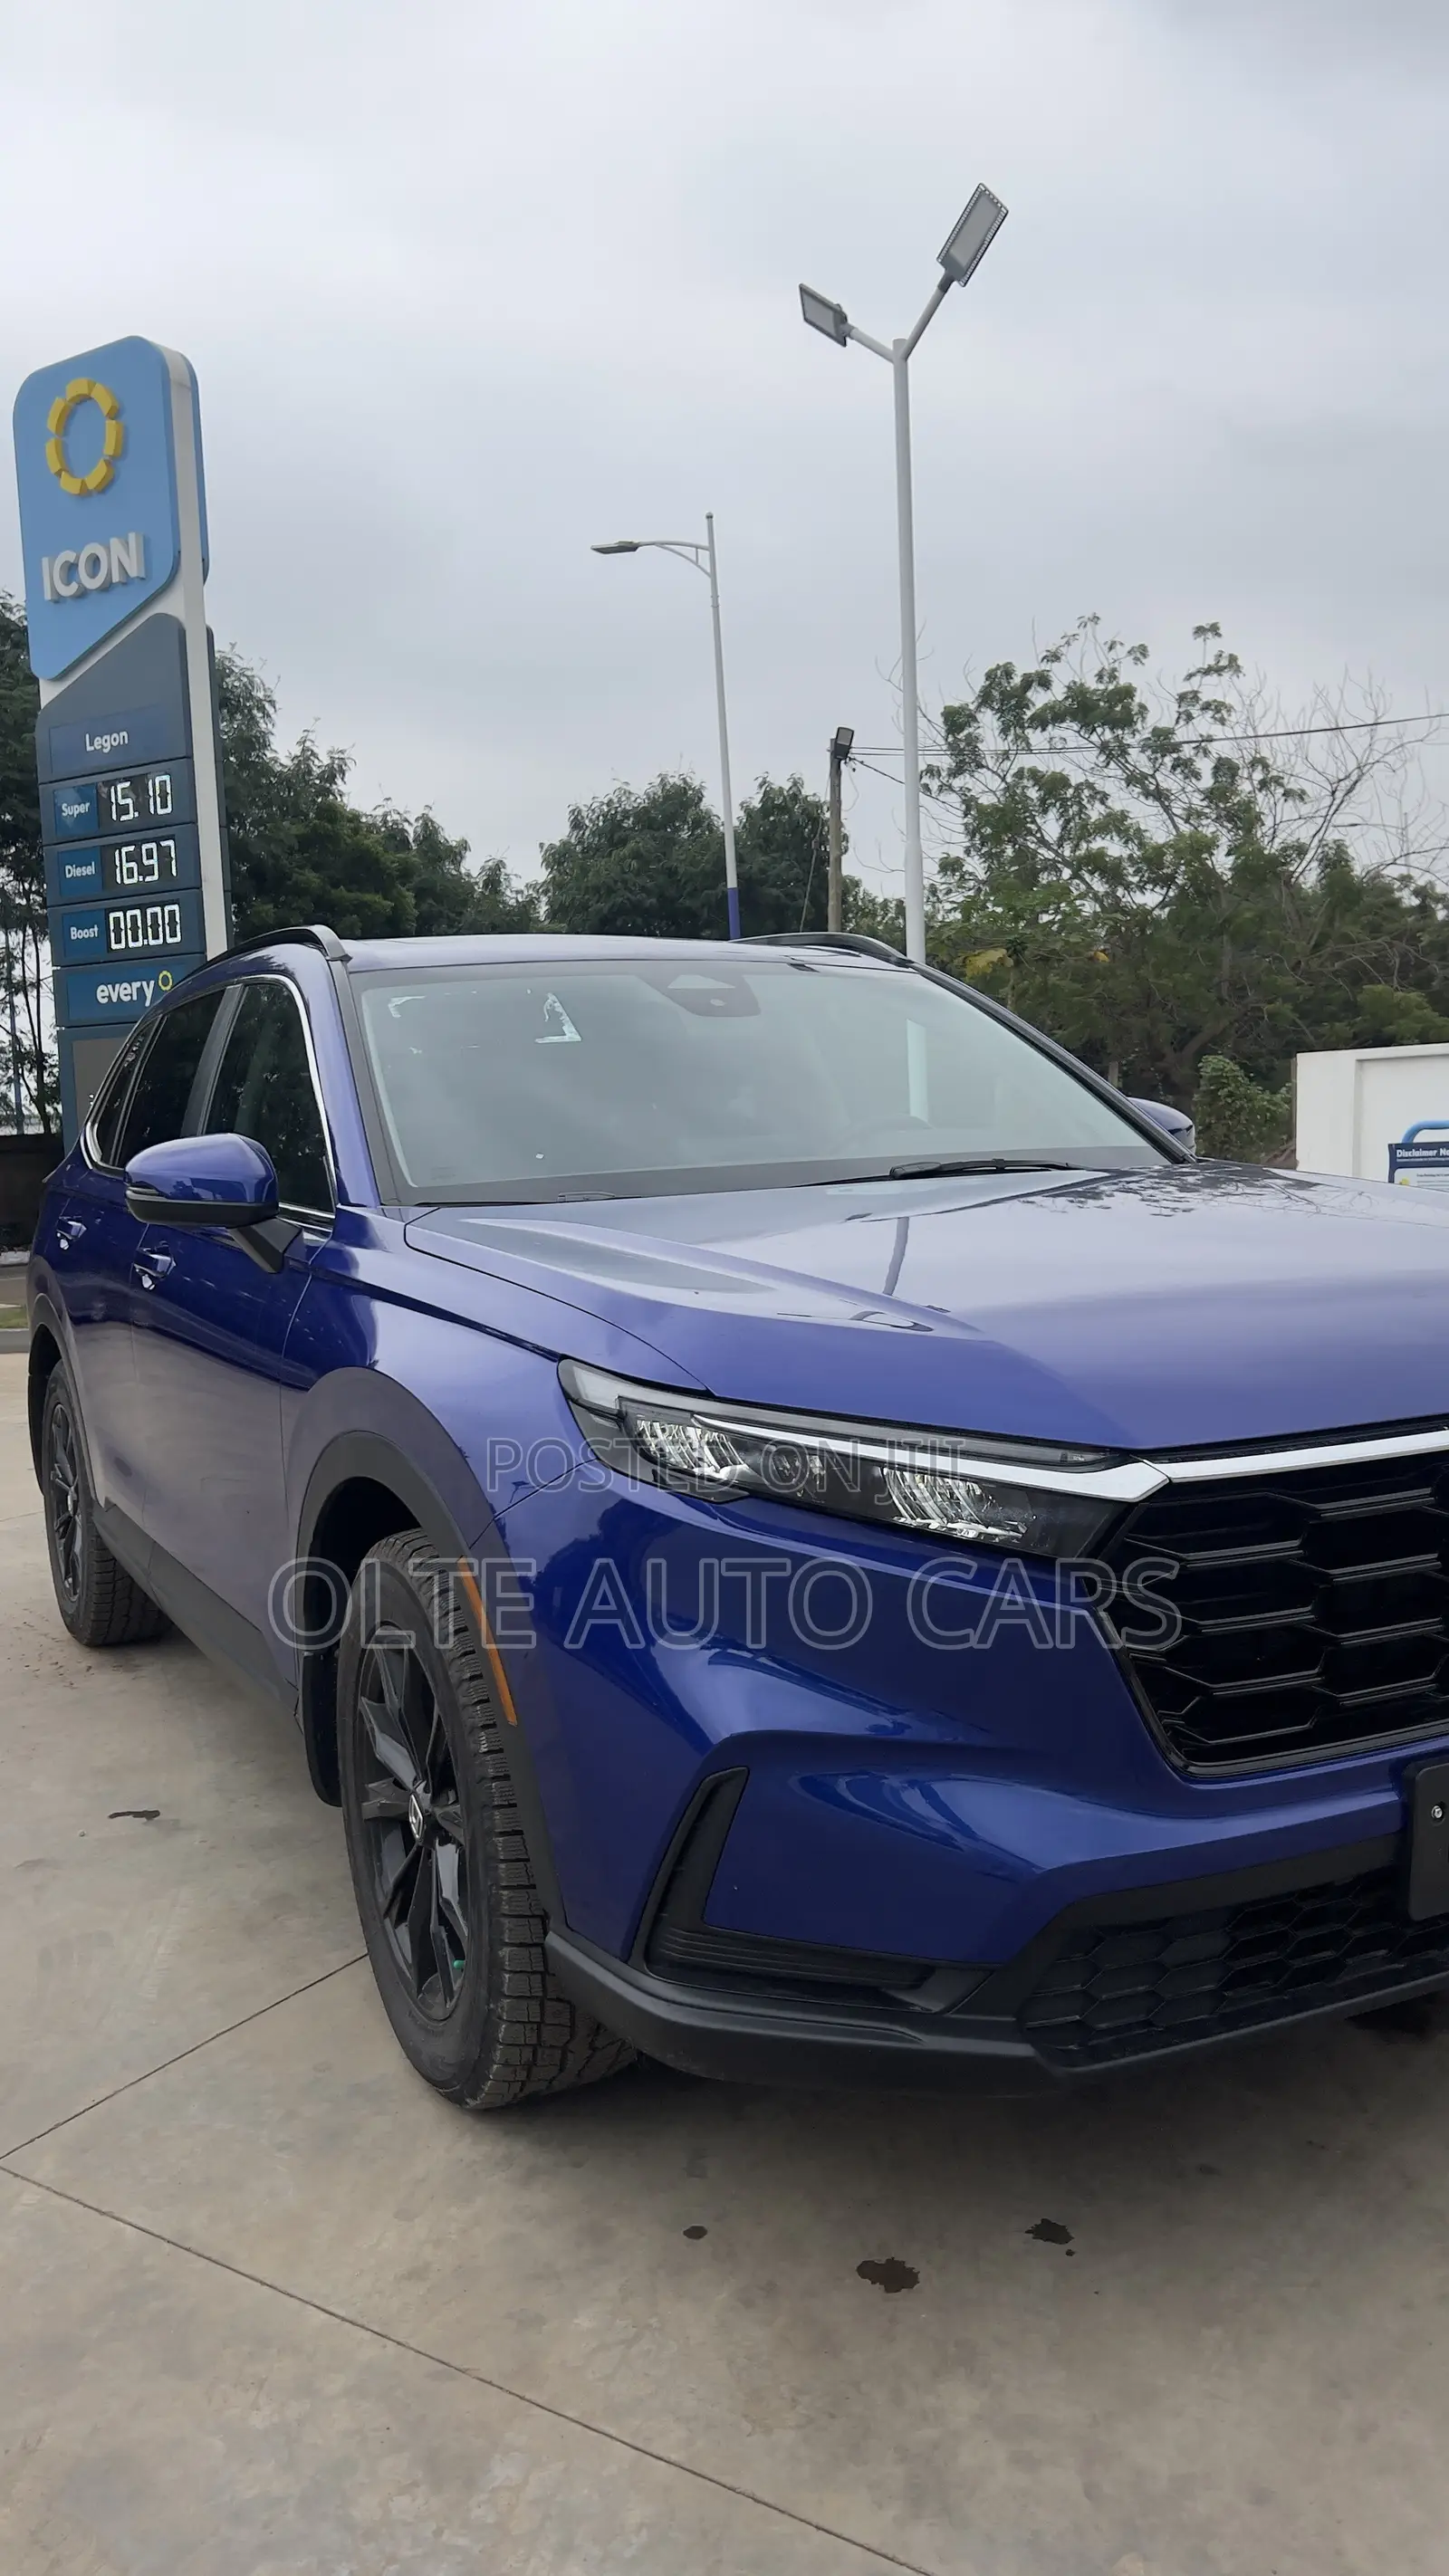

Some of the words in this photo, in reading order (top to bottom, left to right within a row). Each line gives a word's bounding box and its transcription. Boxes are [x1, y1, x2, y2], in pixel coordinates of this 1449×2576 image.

[42, 531, 146, 602] ICON
[85, 731, 129, 753] Legon
[62, 802, 91, 818] Super
[64, 861, 96, 878] Diesel
[114, 839, 178, 885] 16.97
[70, 924, 100, 940] Boost
[109, 905, 181, 951] 00.00
[97, 981, 155, 1007] every
